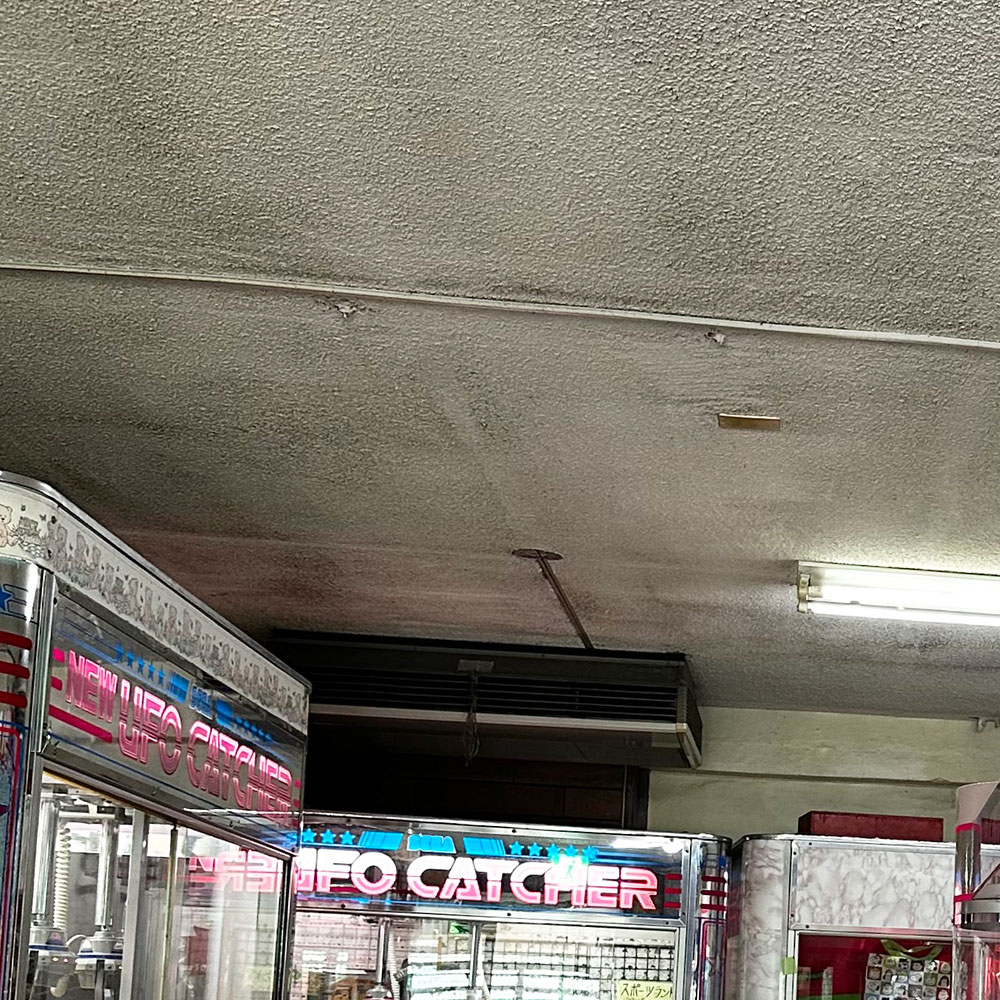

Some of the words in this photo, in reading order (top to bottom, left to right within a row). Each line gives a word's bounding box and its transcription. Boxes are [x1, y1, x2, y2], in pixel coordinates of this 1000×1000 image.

[65, 649, 118, 723] NEW
[118, 679, 182, 775] UFO
[187, 720, 293, 826] CATCHER
[407, 854, 658, 910] CATCHER
